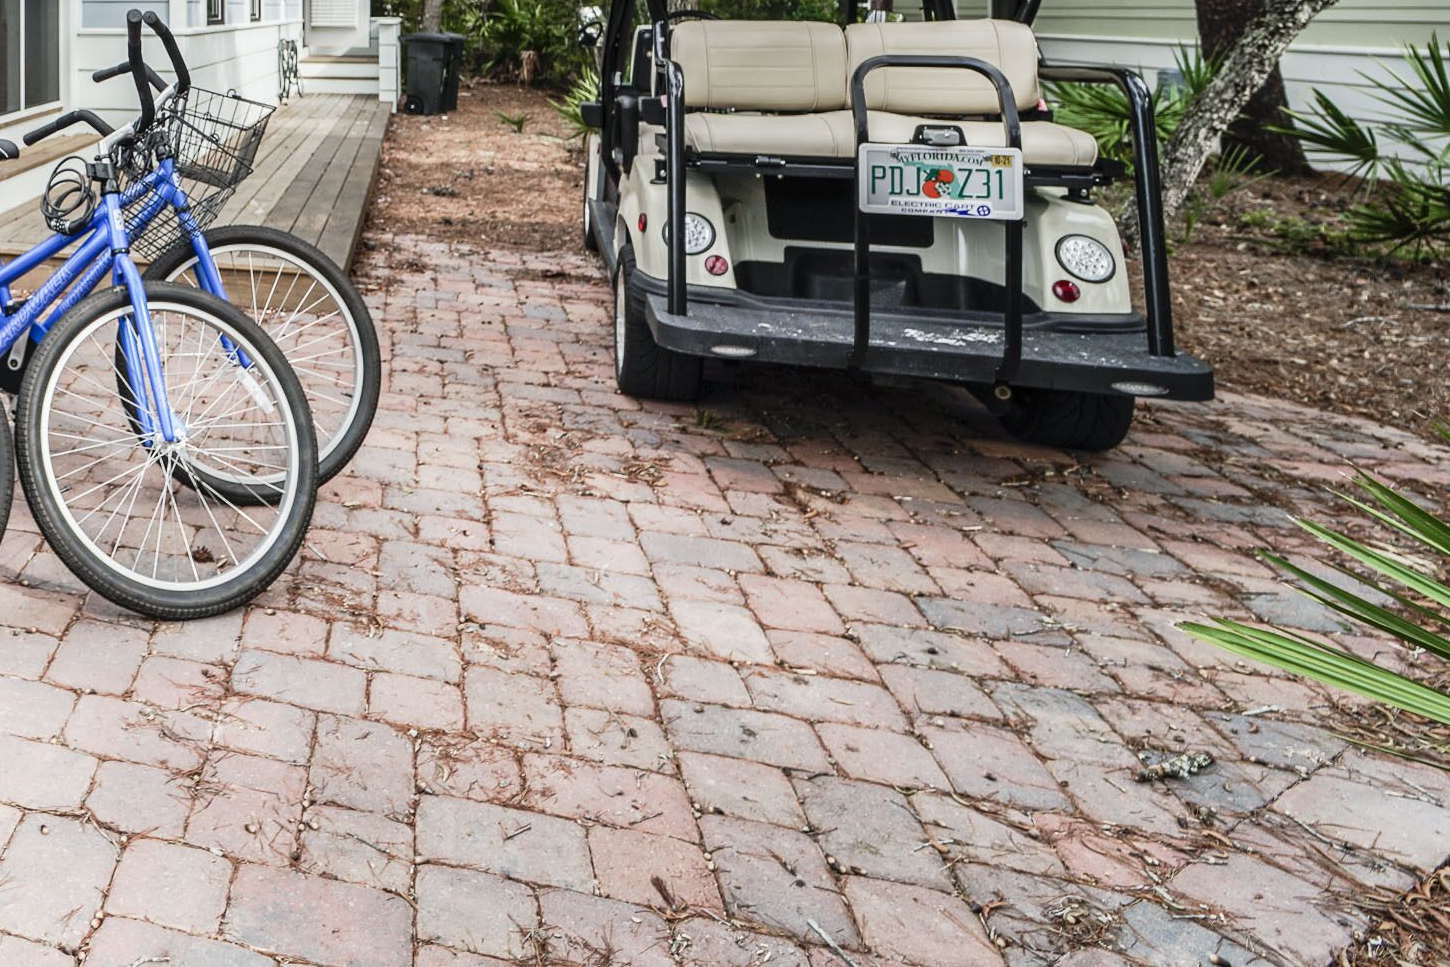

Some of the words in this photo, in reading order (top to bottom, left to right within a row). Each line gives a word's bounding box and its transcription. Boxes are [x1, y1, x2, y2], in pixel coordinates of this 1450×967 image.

[871, 165, 921, 196] PDJ
[958, 168, 1004, 200] Z31
[891, 200, 942, 208] ELECTRIC
[945, 202, 974, 210] CART
